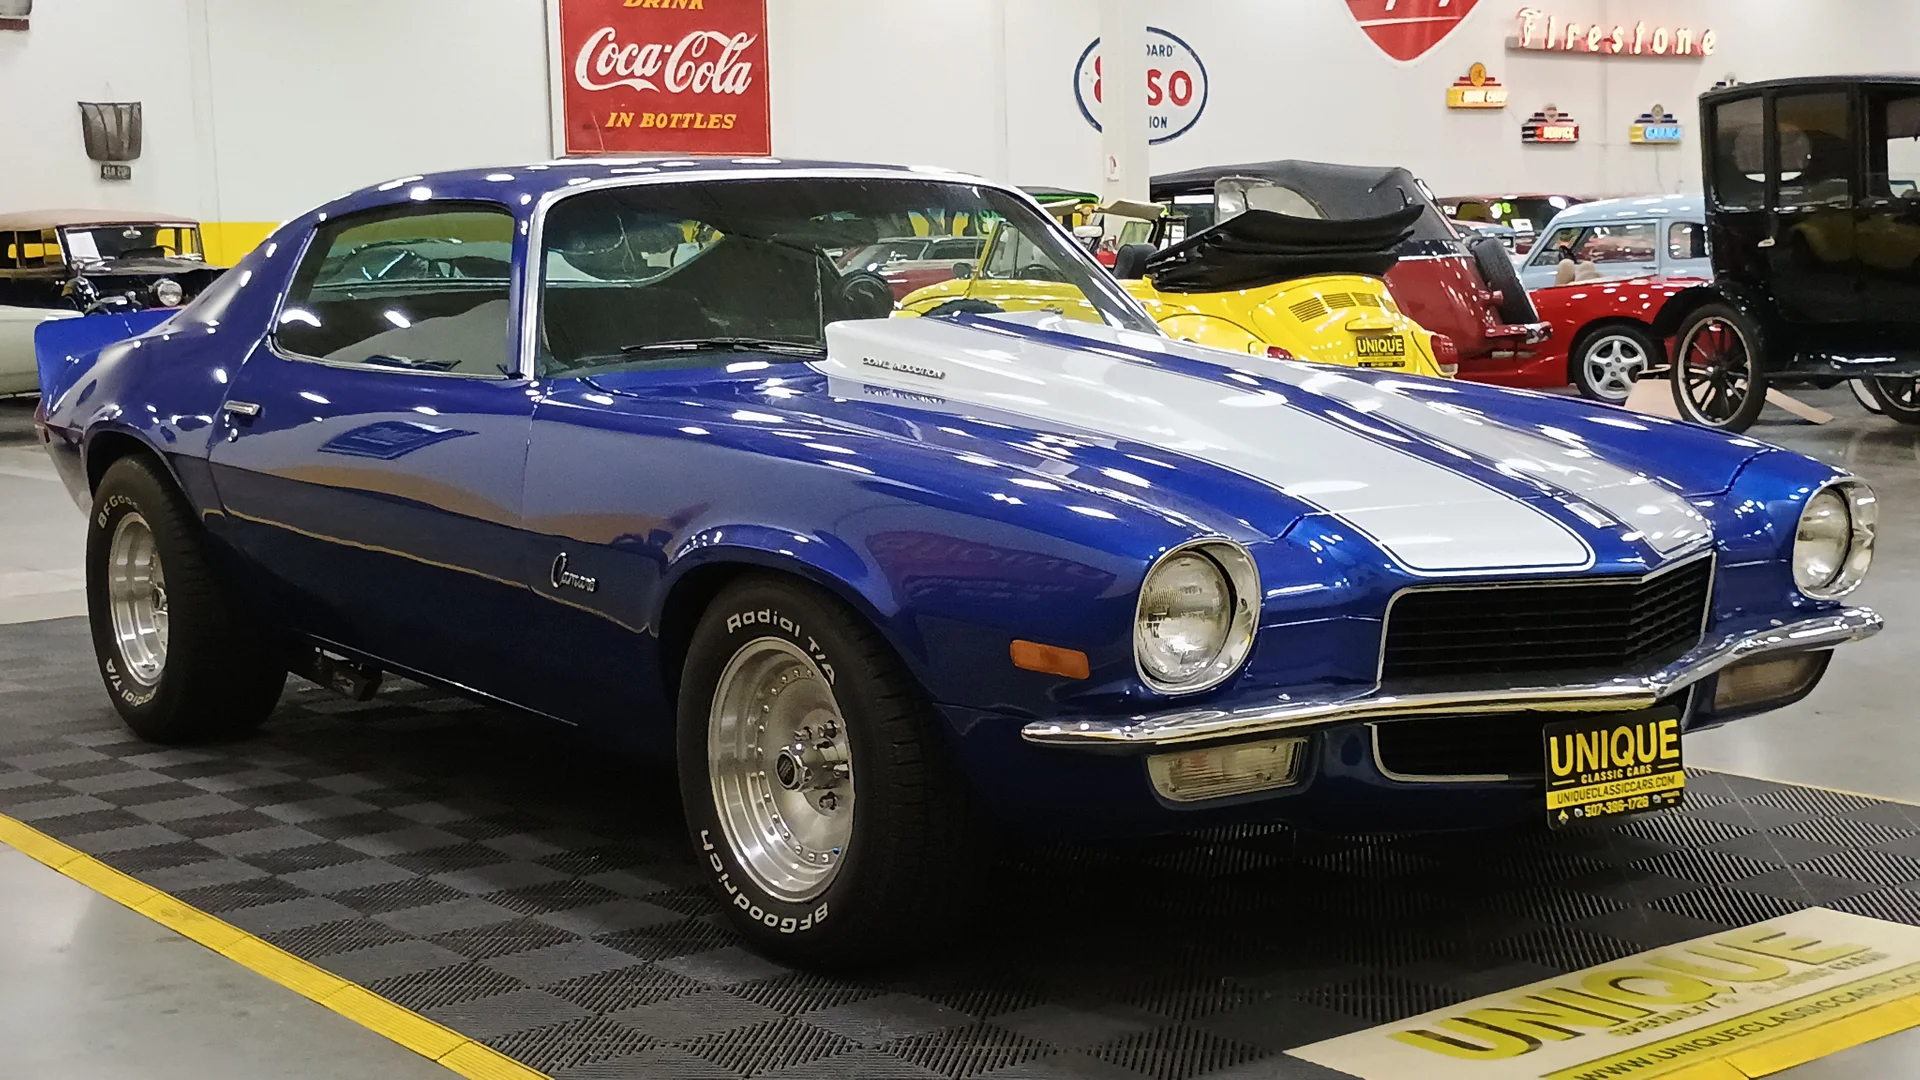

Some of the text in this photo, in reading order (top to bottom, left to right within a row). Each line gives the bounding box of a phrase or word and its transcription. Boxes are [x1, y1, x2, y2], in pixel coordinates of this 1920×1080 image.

[1147, 44, 1173, 57] ARD
[1516, 7, 1716, 56] Firestone
[575, 26, 758, 95] Coca-Cola
[605, 112, 736, 129] IN BOTTLES
[1148, 116, 1168, 129] ION
[1357, 337, 1404, 353] UNIQUE
[551, 552, 596, 592] Camaro
[726, 608, 837, 686] Radial T/A
[1550, 718, 1680, 777] UNIQUE
[1557, 775, 1676, 805] UNIQUECLASSICCARS.COM
[1581, 764, 1652, 784] CLASSIC CARS
[701, 829, 829, 934] BFGoodrich
[1386, 927, 1873, 1061] UNIQUE
